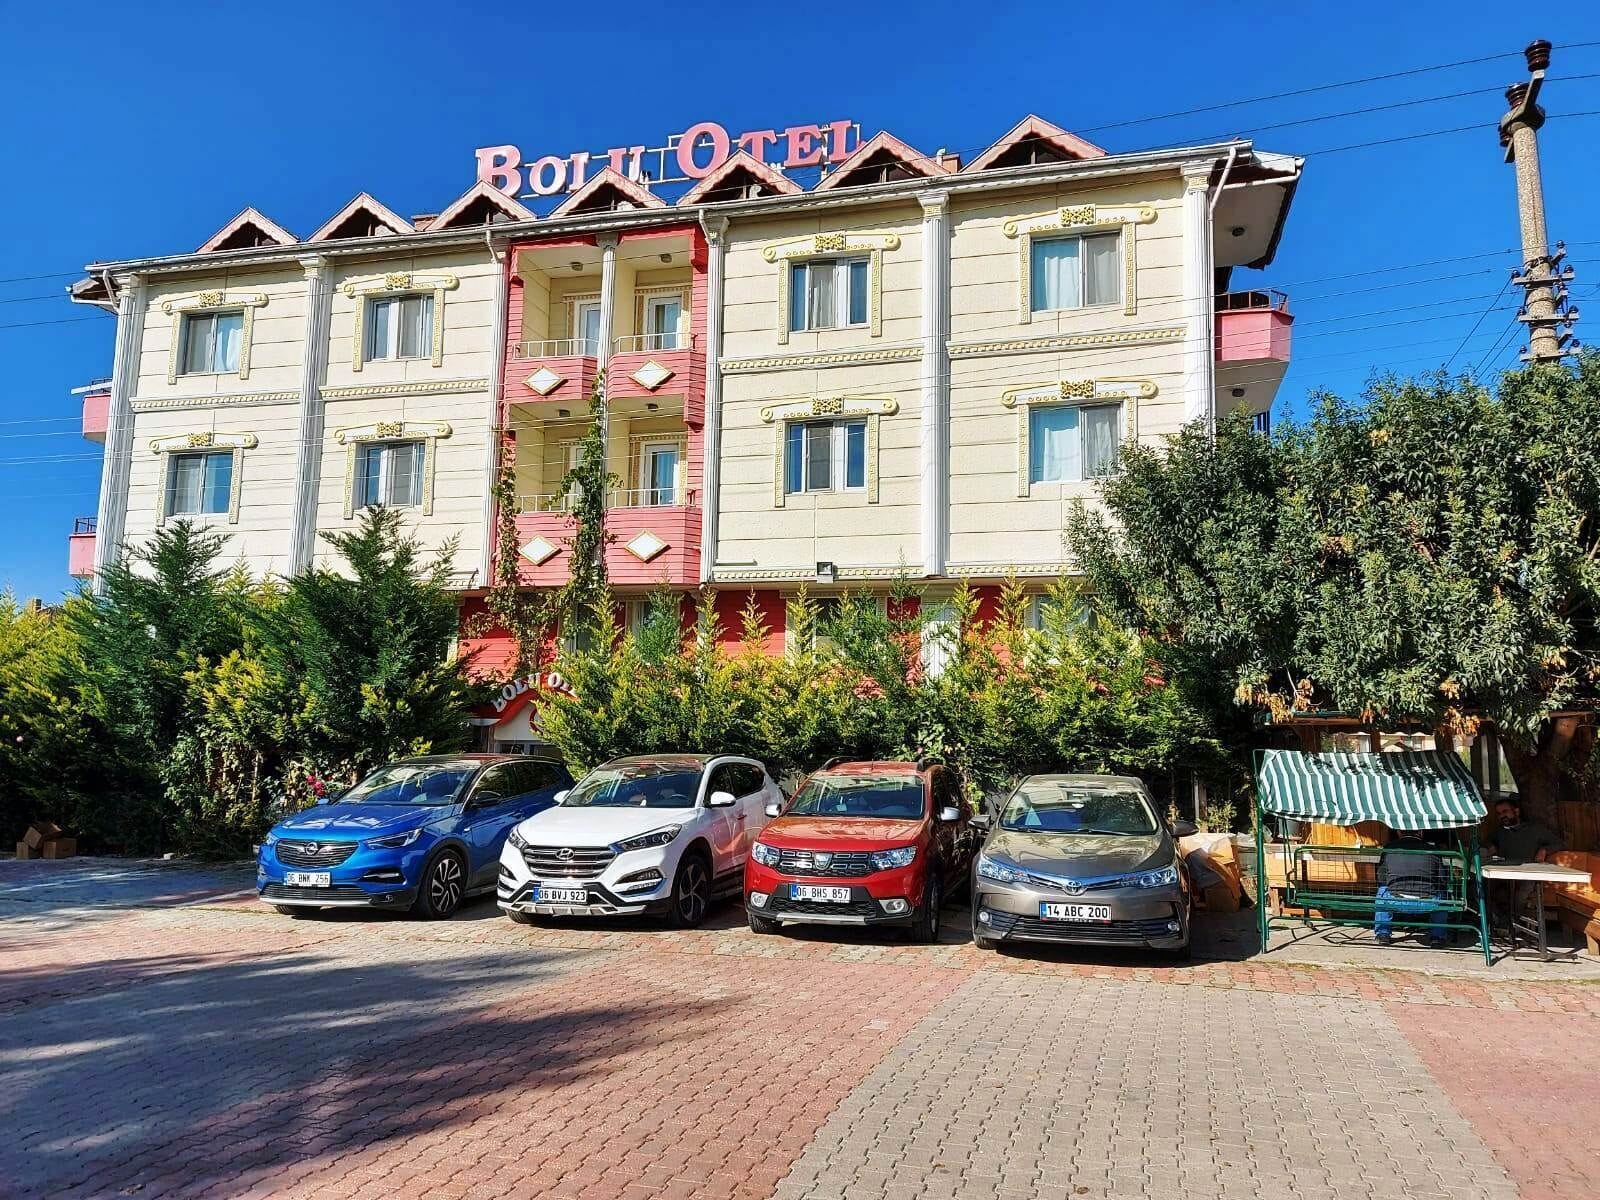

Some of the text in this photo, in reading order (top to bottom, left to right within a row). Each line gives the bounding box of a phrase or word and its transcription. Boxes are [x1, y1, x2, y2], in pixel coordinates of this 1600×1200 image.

[475, 119, 866, 199] BOLU OTEL
[539, 889, 586, 901] 06 BVJ 923
[796, 886, 849, 899] 06 BHS 857
[1047, 905, 1108, 918] 14 ABC 200
